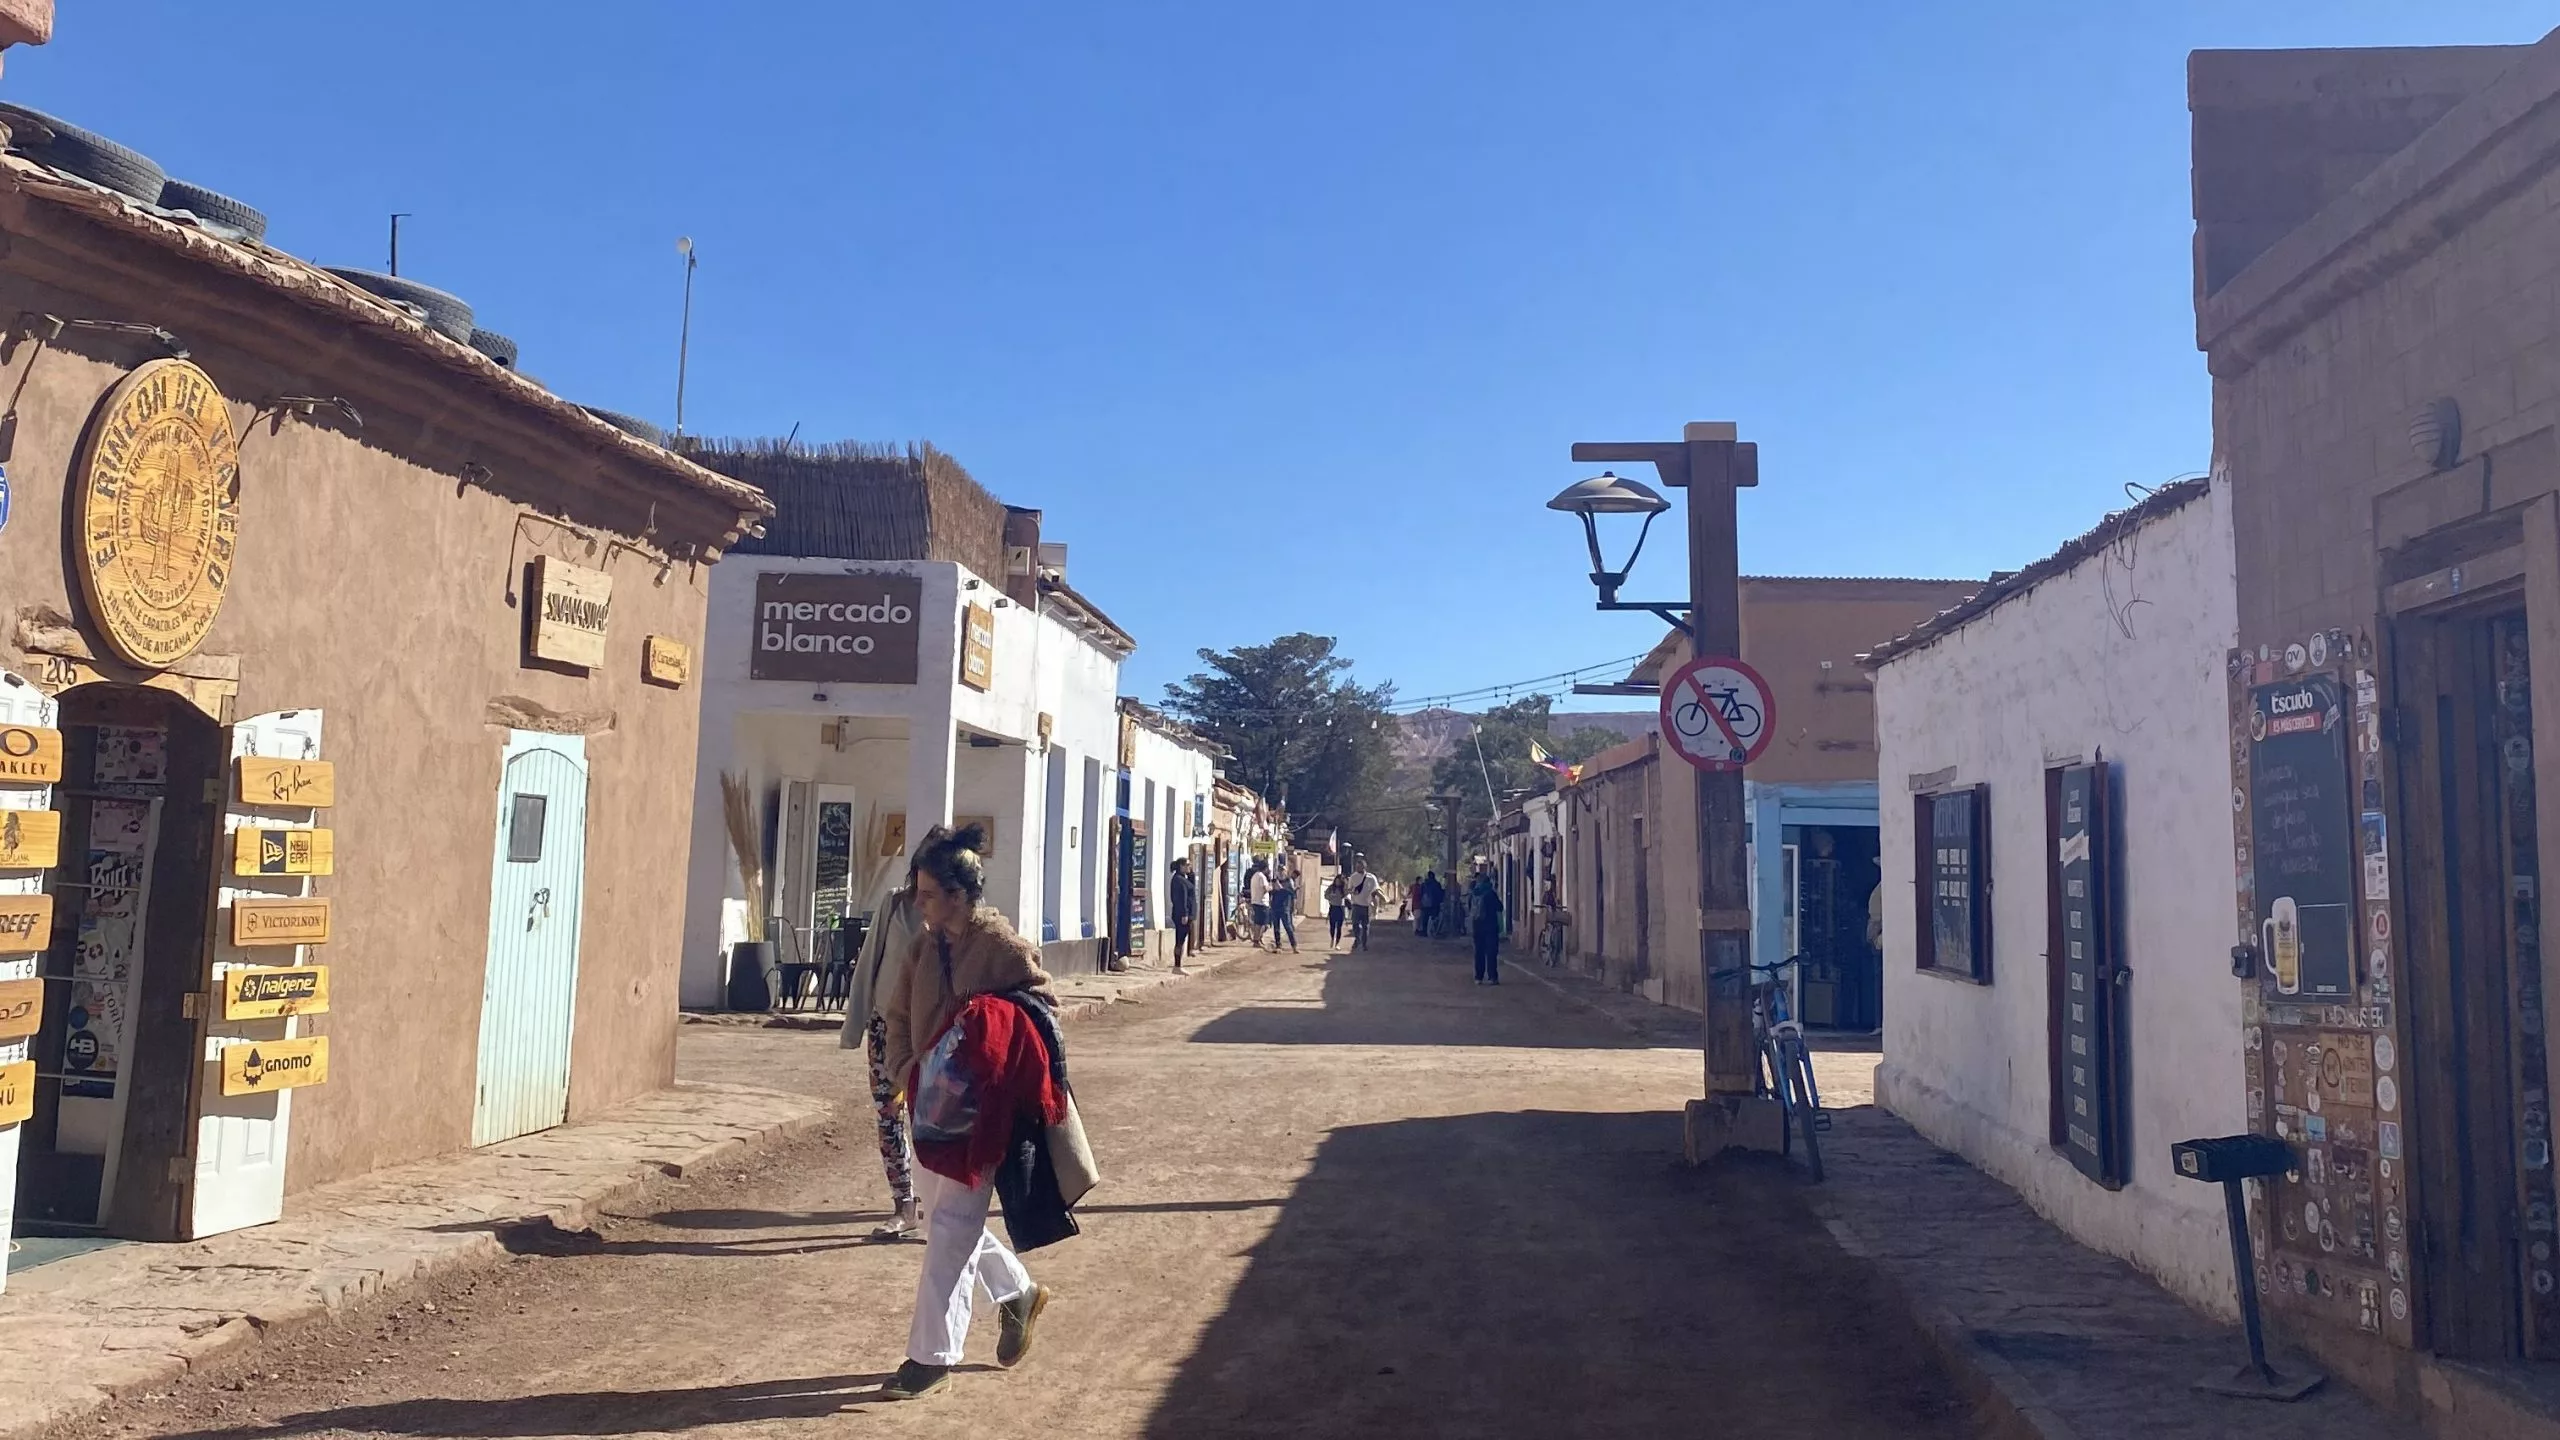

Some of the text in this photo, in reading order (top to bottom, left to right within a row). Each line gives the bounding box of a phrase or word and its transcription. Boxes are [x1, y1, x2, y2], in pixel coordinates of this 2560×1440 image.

[94, 515, 117, 568] EL
[175, 373, 208, 420] DEL
[207, 417, 235, 590] VIAJERO
[192, 488, 210, 566] FOOTWEAR
[107, 590, 121, 619] SAN
[120, 616, 142, 646] PEDRO
[143, 636, 153, 651] DE
[123, 591, 142, 621] CALLE
[763, 594, 912, 624] mercado
[761, 621, 875, 654] blanco
[46, 656, 77, 686] 205
[2270, 687, 2314, 714] Escudo
[289, 839, 309, 851] NEW
[289, 852, 309, 864] ERA
[262, 914, 322, 929] VICTORINOX
[260, 975, 315, 997] nalgene
